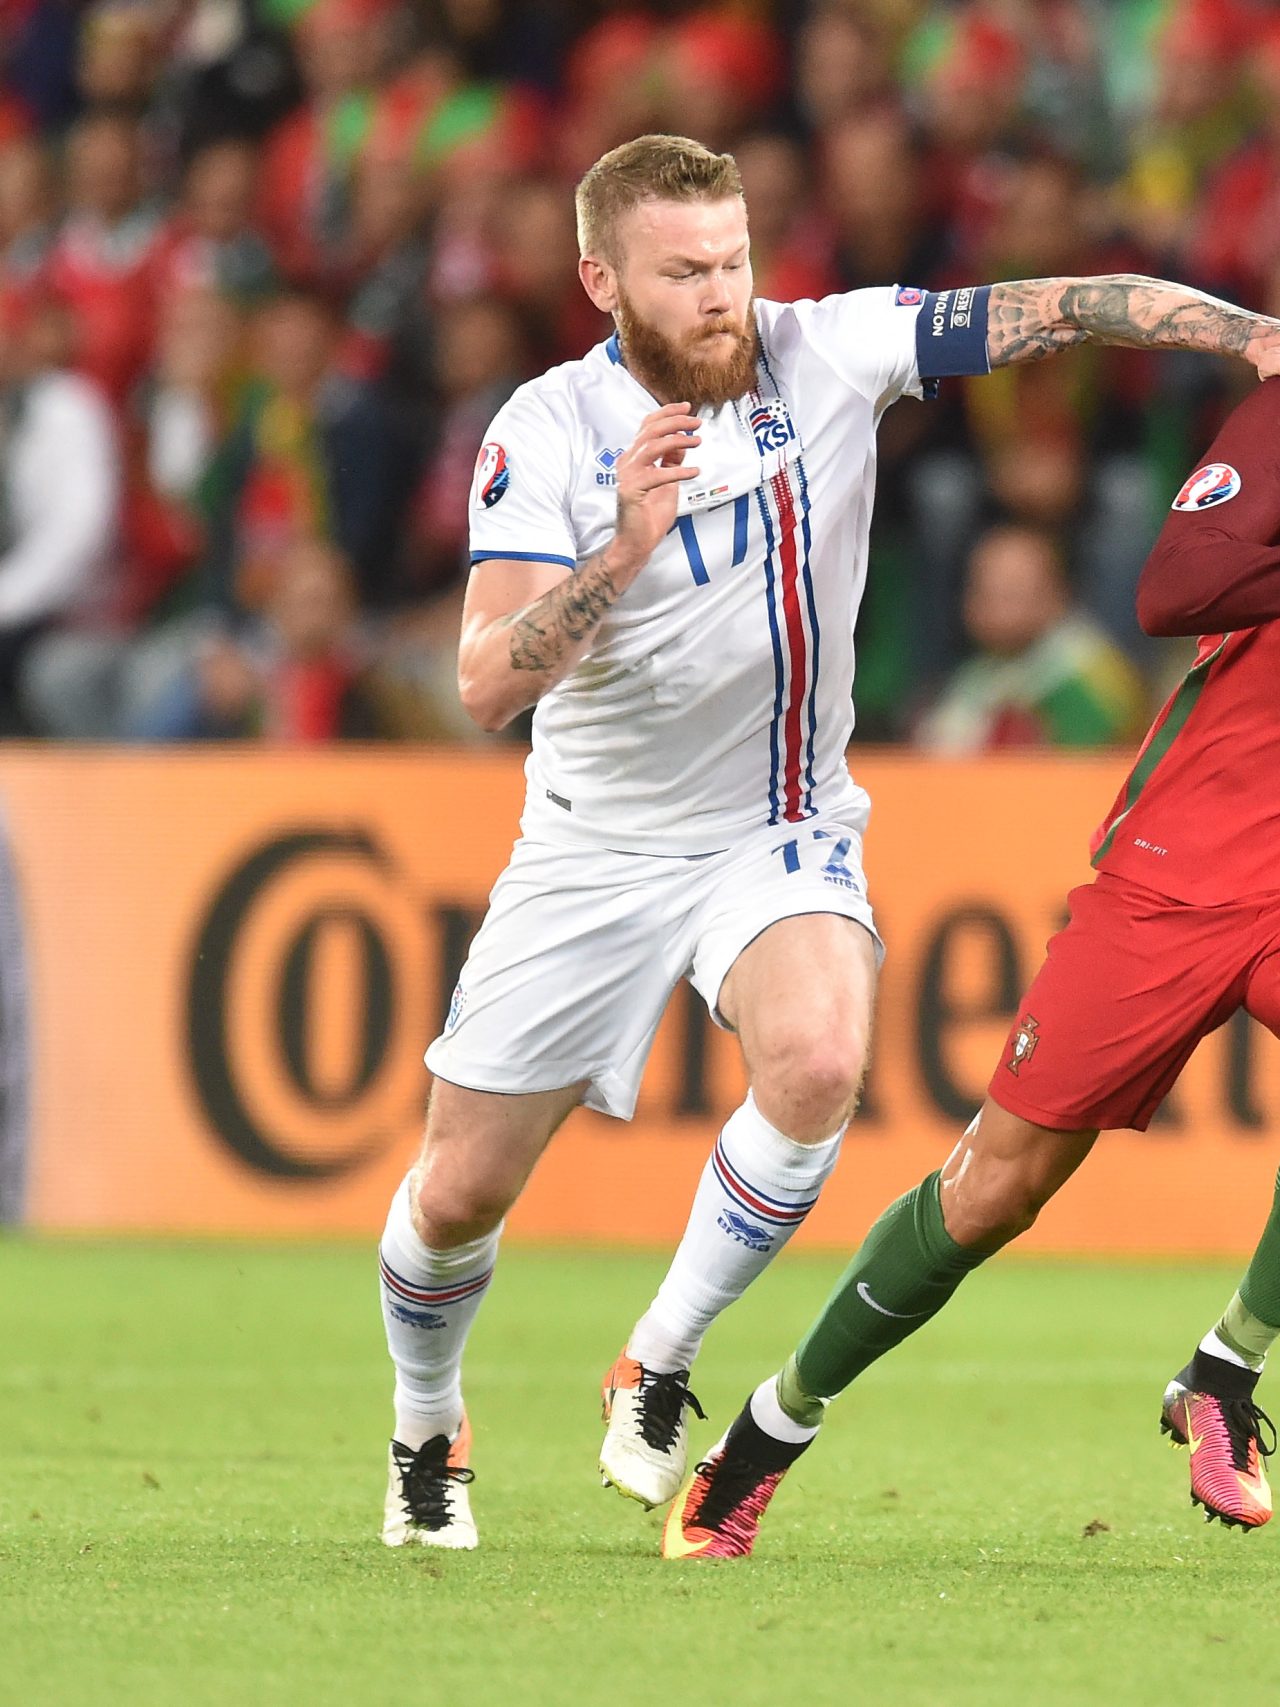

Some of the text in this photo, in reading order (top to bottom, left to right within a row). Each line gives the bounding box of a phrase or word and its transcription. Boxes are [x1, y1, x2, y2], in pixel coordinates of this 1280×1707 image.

[934, 302, 947, 315] TO
[957, 287, 973, 311] RESP
[932, 315, 945, 336] NO
[596, 472, 617, 485] err
[667, 493, 750, 586] 17
[1134, 838, 1168, 857] DRI-FIT
